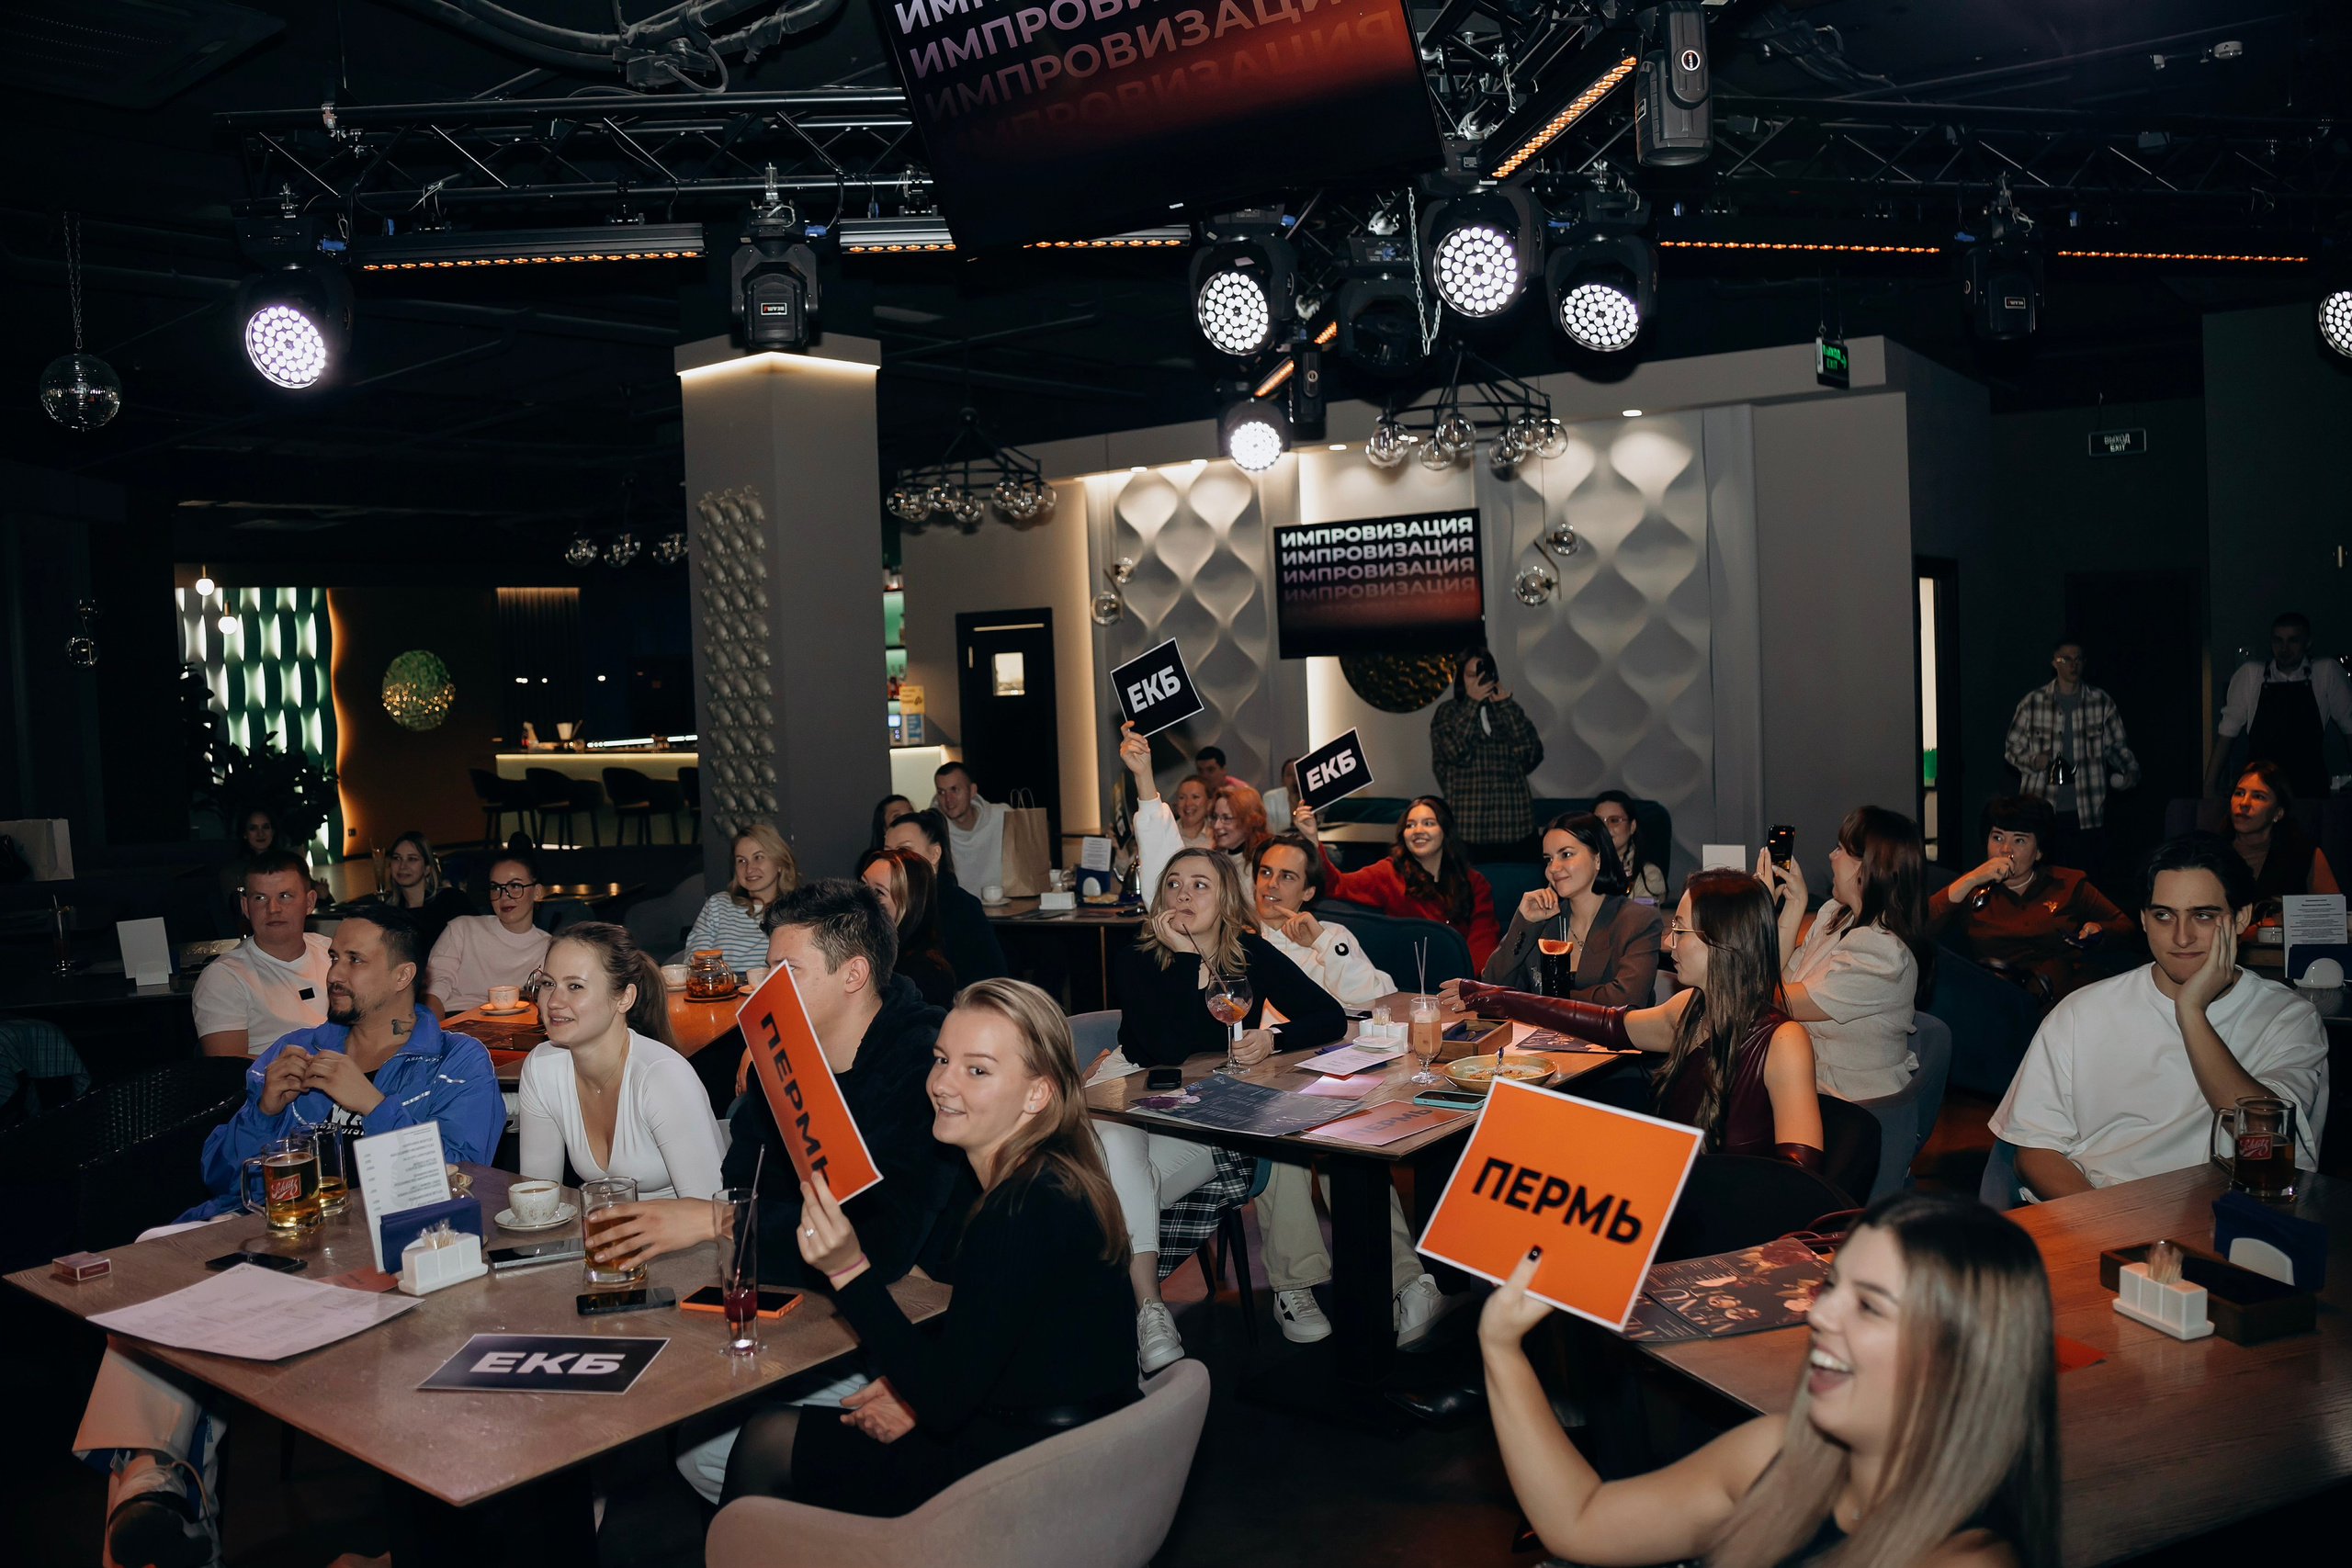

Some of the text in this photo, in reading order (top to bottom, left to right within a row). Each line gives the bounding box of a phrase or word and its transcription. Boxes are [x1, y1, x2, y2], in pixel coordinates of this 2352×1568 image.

[1281, 516, 1473, 547] ИМПРОВИЗАЦИЯ
[1282, 536, 1475, 566] ИМПРОВИЗАЦИЯ
[1283, 557, 1476, 584] ИМПРОВИЗАЦИЯ
[1284, 577, 1476, 602] ИМПРОВИЗАЦИЯ
[1127, 665, 1182, 714] ЕКБ
[1306, 749, 1357, 792] ЕКБ
[1347, 1108, 1433, 1137] ПЕРМЬ
[1472, 1156, 1642, 1245] ПЕРМЬ
[469, 1351, 626, 1374] ЕКБ
